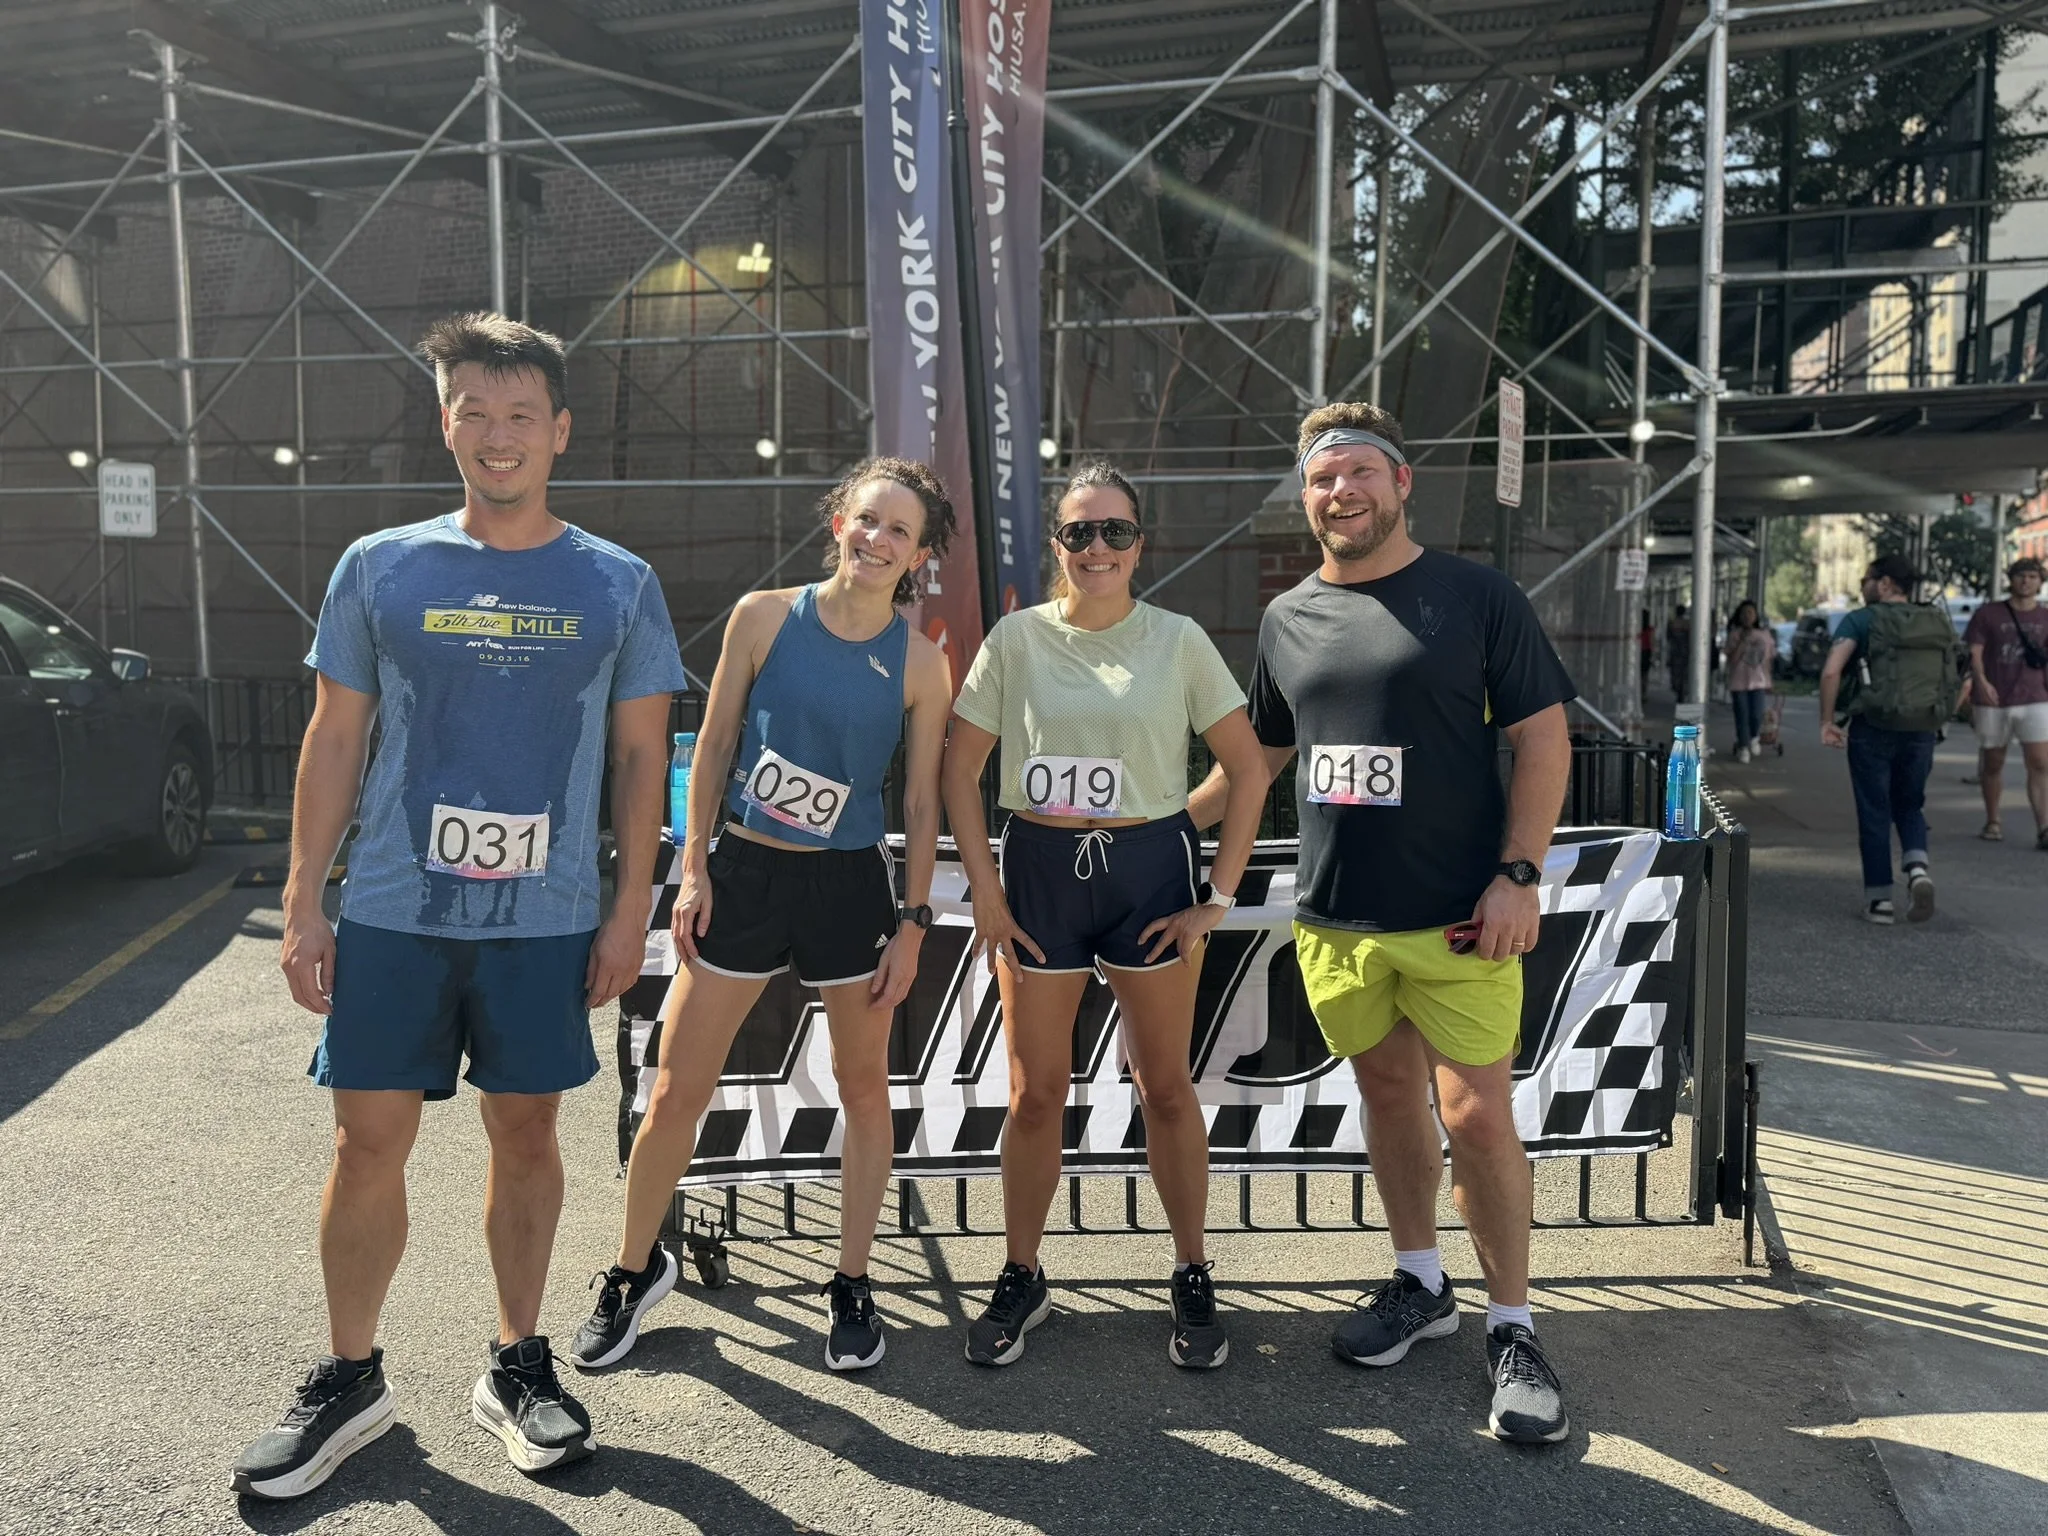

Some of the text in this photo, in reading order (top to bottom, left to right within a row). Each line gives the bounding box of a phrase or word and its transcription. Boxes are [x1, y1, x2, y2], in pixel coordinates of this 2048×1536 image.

[889, 63, 918, 193] CITY
[981, 103, 1005, 216] CITY
[897, 210, 940, 370] YORK
[994, 383, 1013, 500] NEW
[104, 474, 149, 488] HEAD IN
[104, 491, 150, 508] PARKING
[114, 510, 142, 525] ONLY
[1000, 517, 1014, 566] HI
[433, 613, 469, 629] 5th
[516, 618, 579, 635] MILE
[518, 604, 557, 613] balance
[479, 653, 530, 662] 09.03.16
[754, 762, 839, 826] 029
[1026, 763, 1115, 808] 019
[1314, 754, 1395, 796] 018
[438, 817, 537, 870] 031
